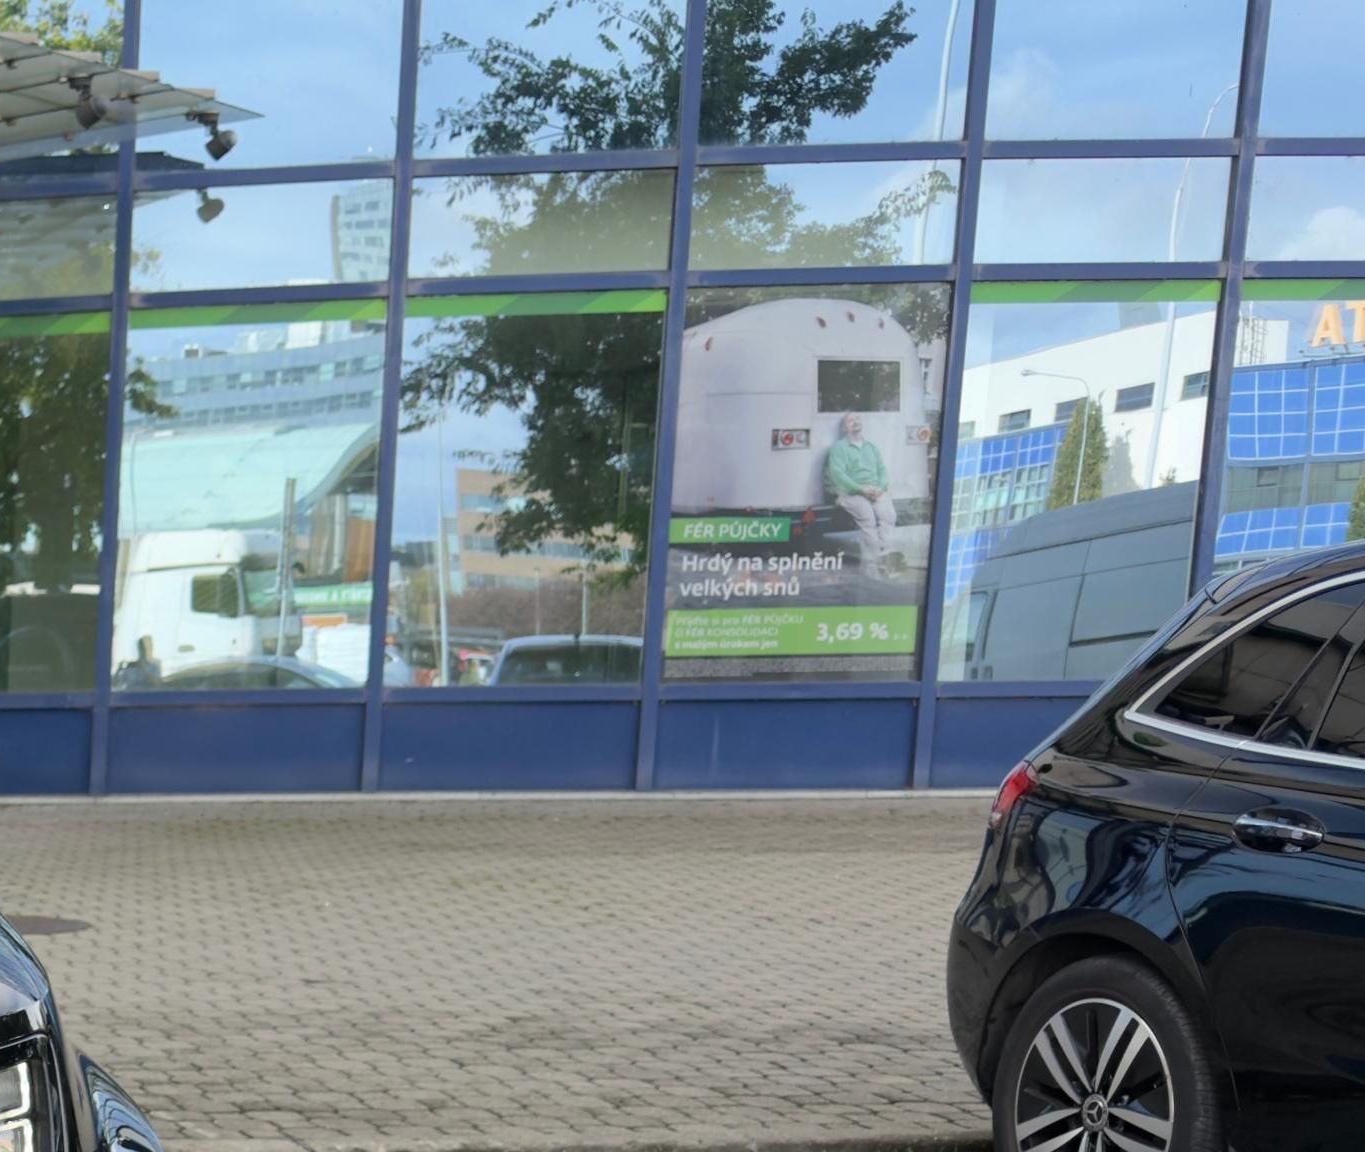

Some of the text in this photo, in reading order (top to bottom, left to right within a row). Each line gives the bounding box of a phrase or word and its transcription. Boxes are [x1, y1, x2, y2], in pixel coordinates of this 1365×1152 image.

[683, 522, 714, 538] FÉR
[682, 550, 845, 576] Hrdý na splnění
[680, 576, 801, 600] velkých snů
[816, 622, 864, 643] 3,69
[869, 622, 889, 640] %
